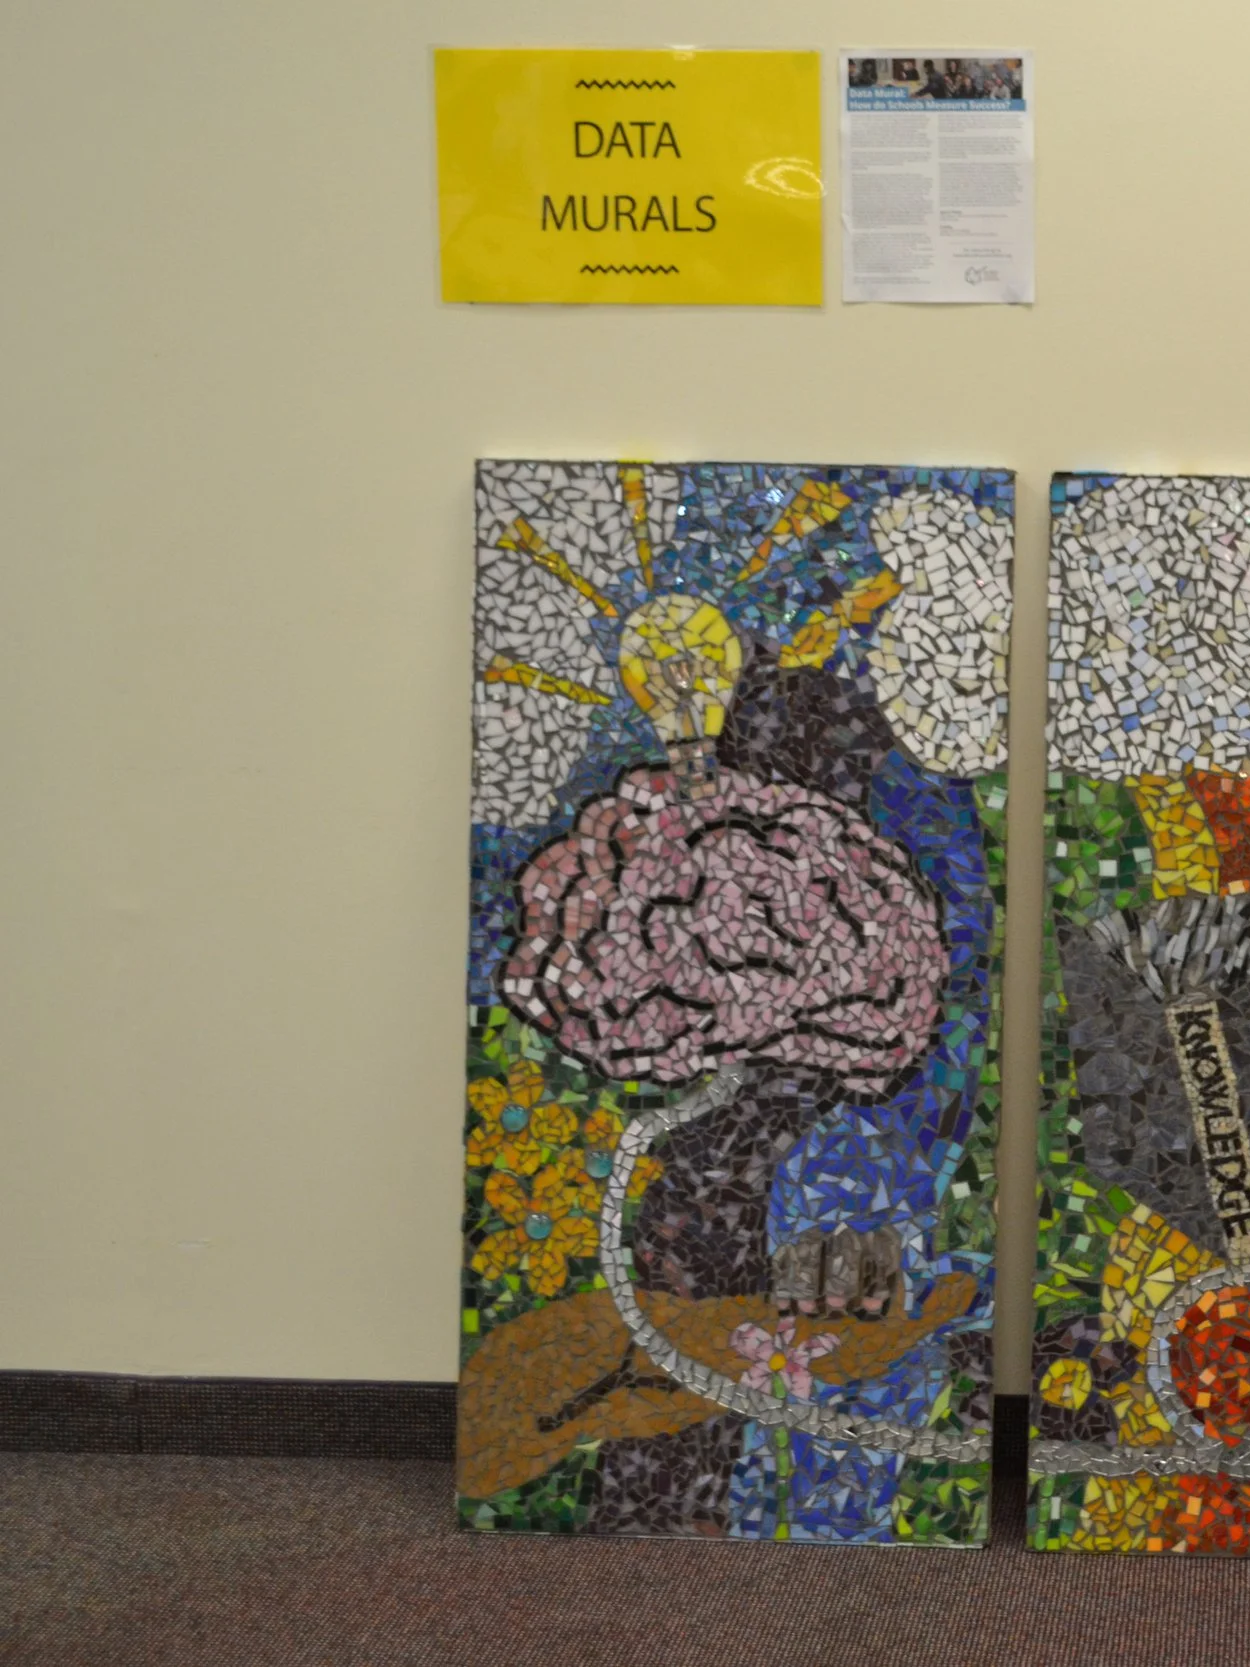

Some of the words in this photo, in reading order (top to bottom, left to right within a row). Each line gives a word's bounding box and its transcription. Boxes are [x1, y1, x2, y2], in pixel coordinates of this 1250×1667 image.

[849, 88, 873, 98] Data
[889, 100, 925, 110] Schools
[926, 100, 968, 110] Measure
[574, 121, 682, 159] DATA
[541, 195, 717, 232] MURALS
